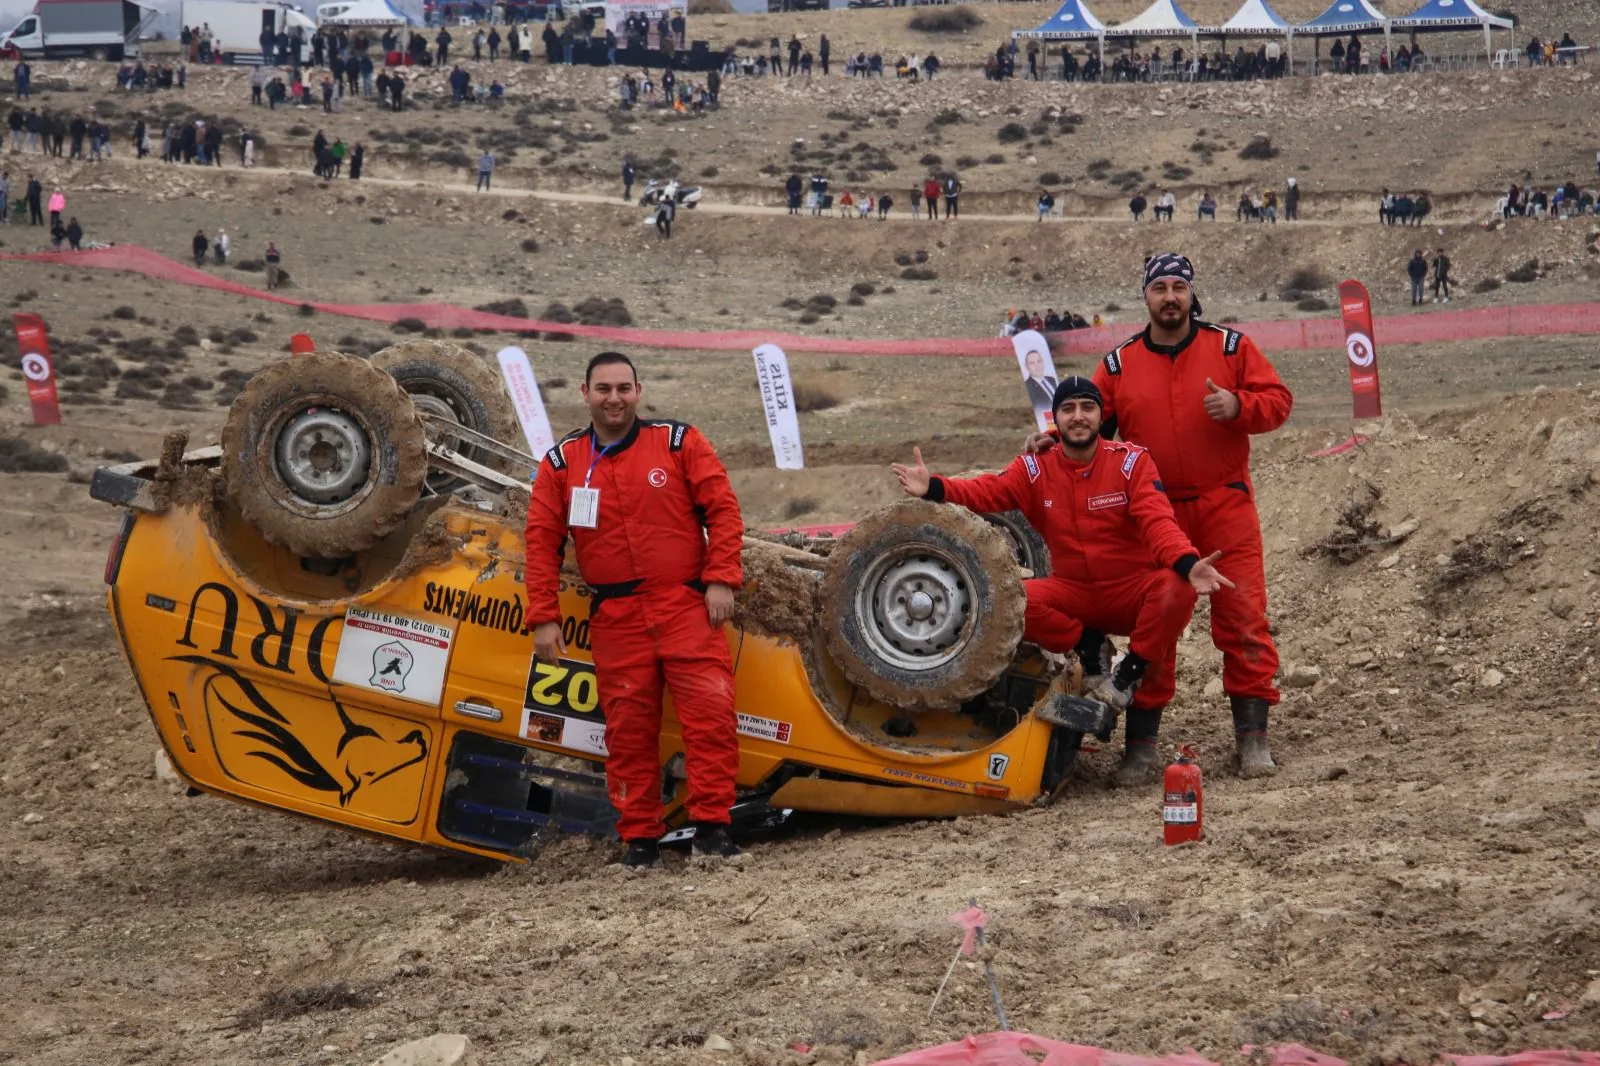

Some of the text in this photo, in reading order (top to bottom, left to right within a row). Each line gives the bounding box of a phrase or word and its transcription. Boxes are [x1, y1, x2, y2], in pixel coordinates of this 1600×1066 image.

[372, 611, 381, 620] 11
[383, 614, 392, 623] 19
[394, 617, 410, 627] 480
[411, 621, 435, 634] (0312)
[437, 628, 451, 639] TEL:
